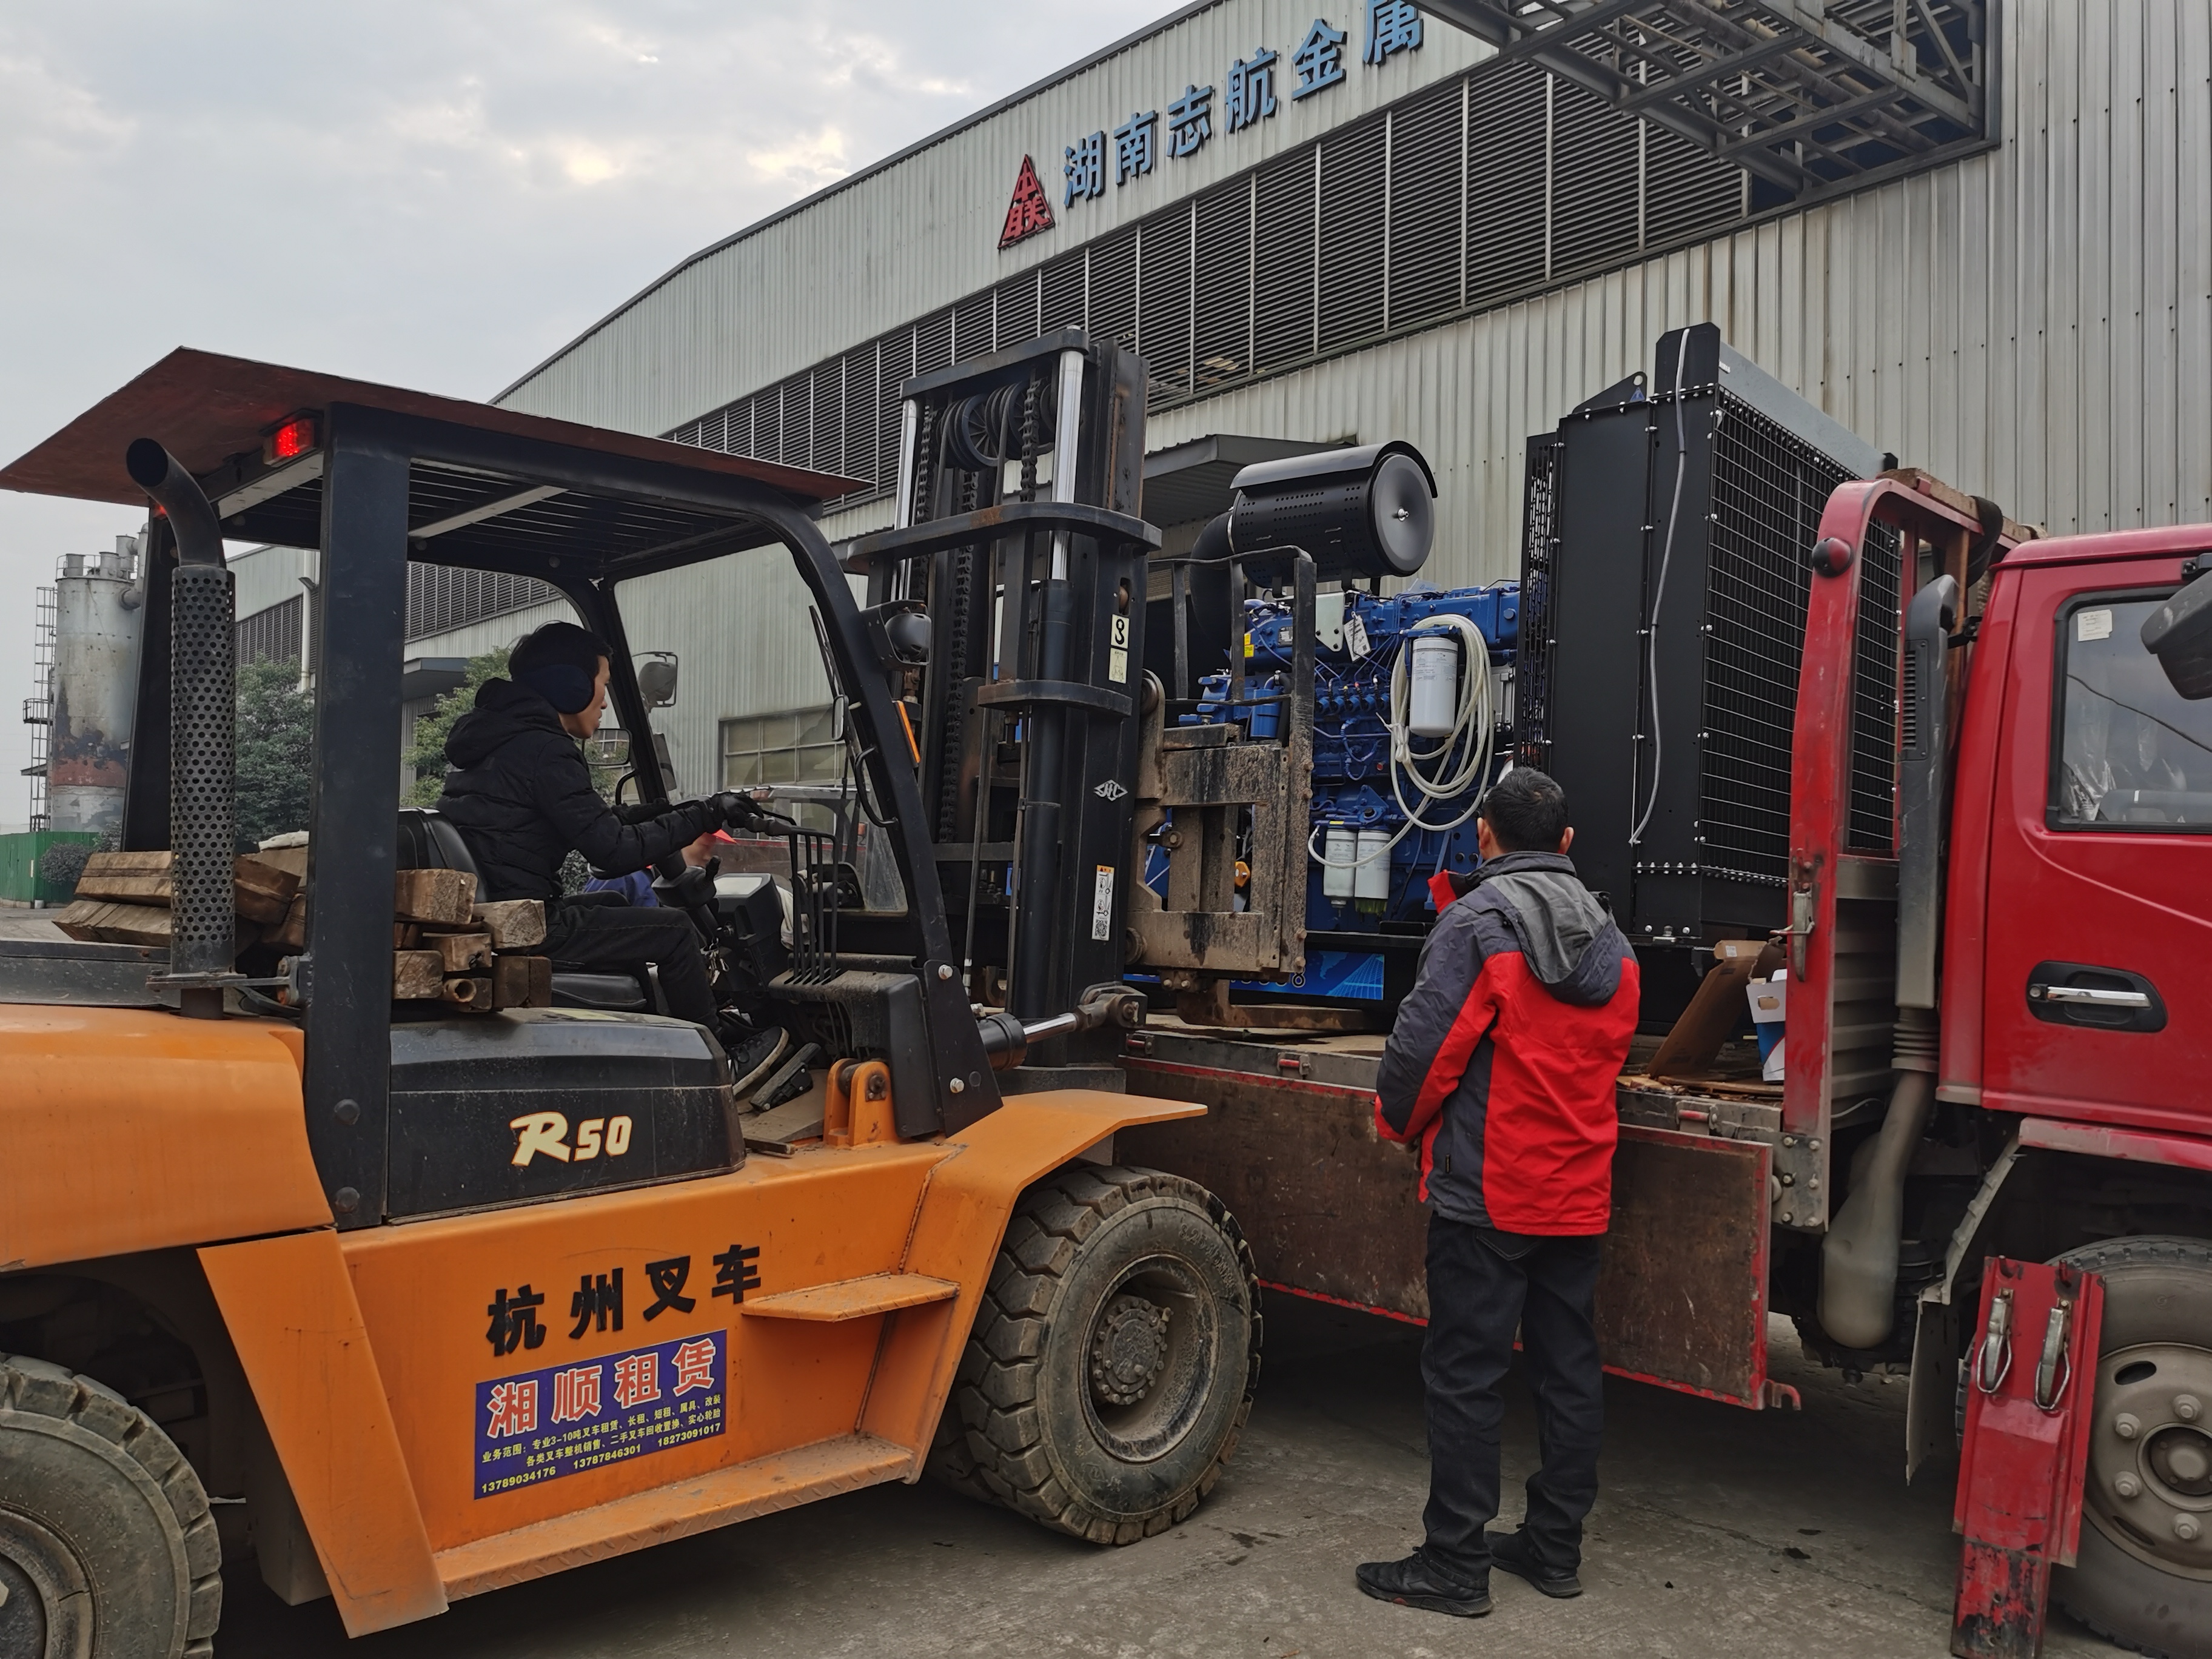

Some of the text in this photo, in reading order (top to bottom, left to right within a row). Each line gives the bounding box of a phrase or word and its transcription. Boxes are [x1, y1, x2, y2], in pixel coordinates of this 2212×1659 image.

[1064, 0, 1423, 208] 湖南志航金属
[509, 1111, 632, 1167] R50
[486, 1244, 762, 1356] 杭州叉车
[486, 1338, 717, 1439] 湘顺租赁
[481, 1422, 721, 1493] 13789034176 13787846301 18273091017
